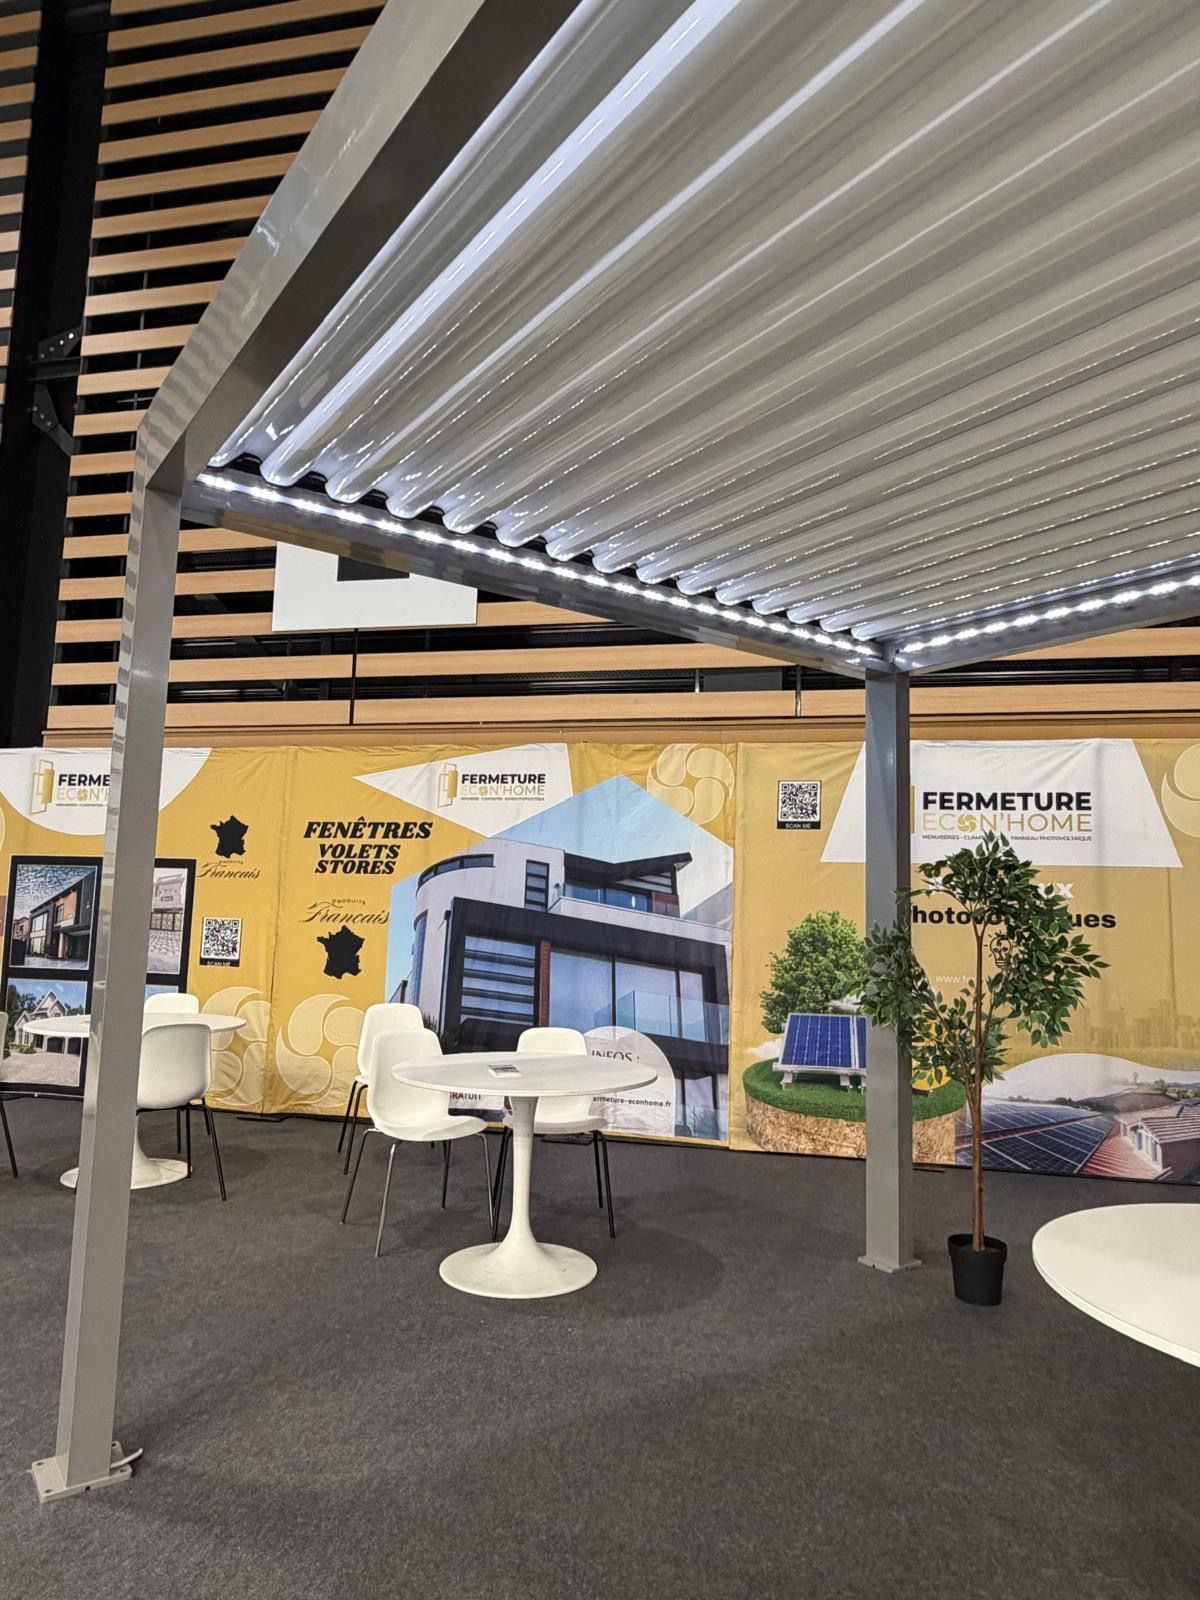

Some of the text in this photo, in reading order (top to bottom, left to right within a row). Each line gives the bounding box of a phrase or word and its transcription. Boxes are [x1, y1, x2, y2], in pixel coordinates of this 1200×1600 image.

[58, 773, 110, 787] FERME
[461, 773, 546, 785] FERMETURE
[922, 791, 1092, 811] FERMETURE
[303, 816, 433, 839] FENÊTRES
[319, 843, 401, 859] VOLETS
[315, 860, 396, 875] STORES
[592, 1096, 672, 1107] ermeture-econhome.fr
